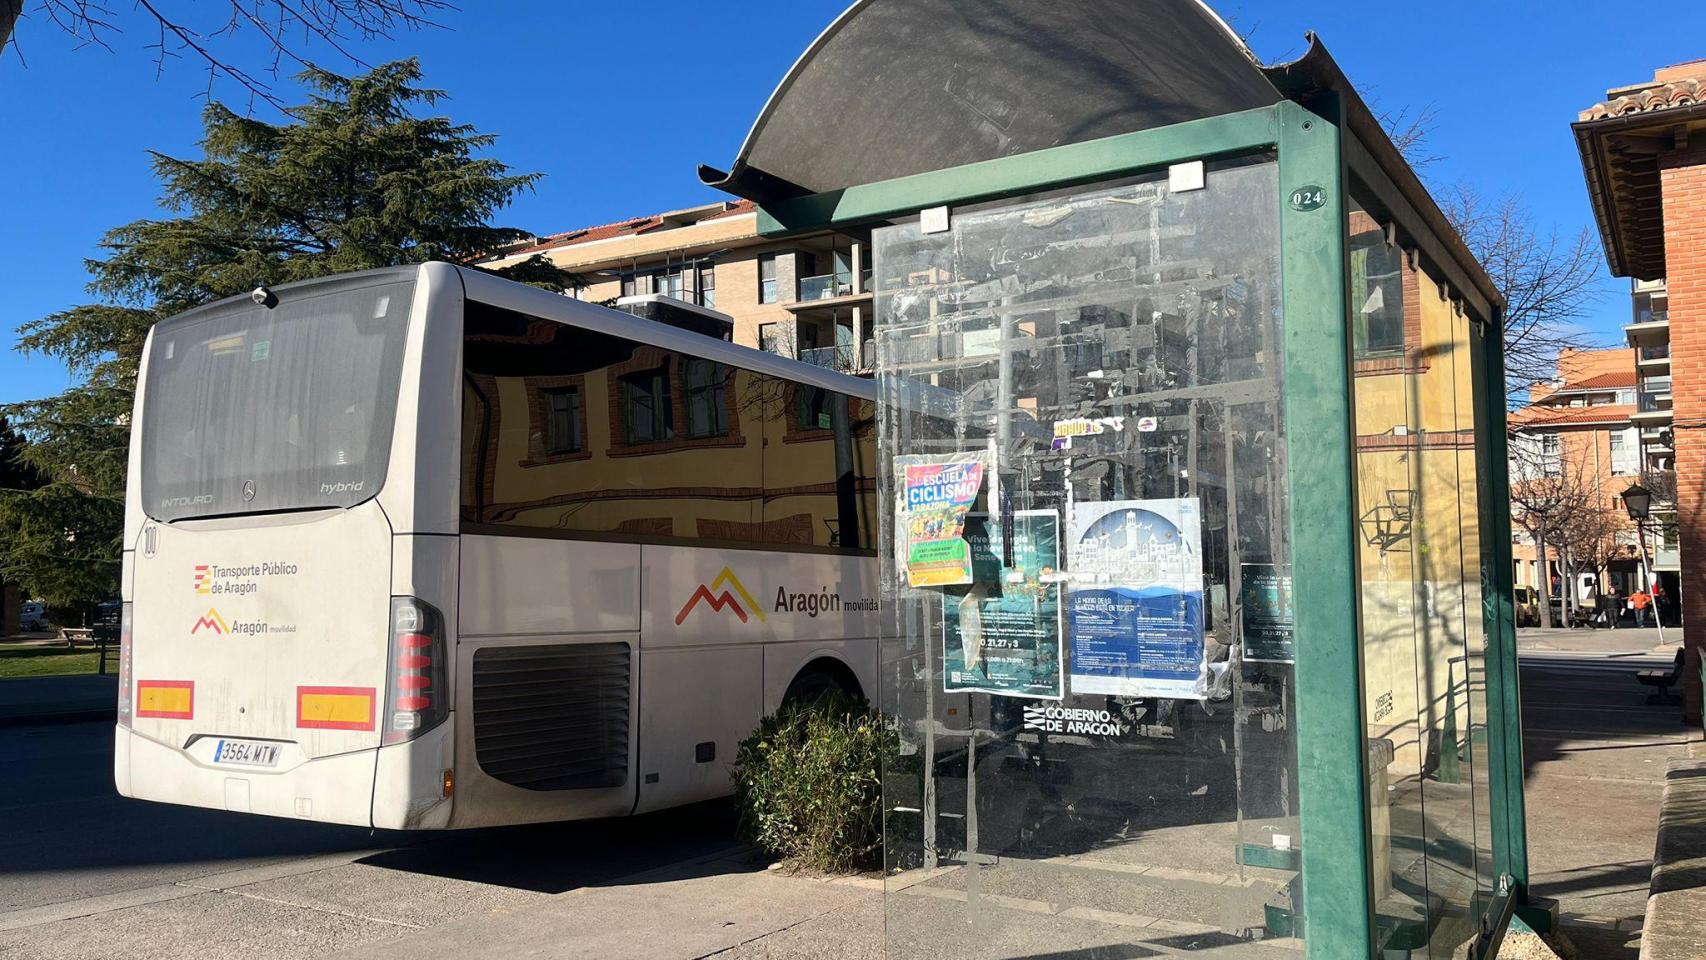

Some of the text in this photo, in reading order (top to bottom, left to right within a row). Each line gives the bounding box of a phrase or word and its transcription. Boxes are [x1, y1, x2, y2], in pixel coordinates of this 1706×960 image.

[1293, 191, 1321, 205] 024
[923, 470, 968, 486] ESCUELA
[320, 481, 364, 495] hybrid
[910, 481, 976, 503] CICLISMO
[161, 494, 214, 508] INTOURO
[212, 562, 298, 579] Transporte Público
[211, 580, 257, 595] de Aragón
[775, 586, 840, 618] Aragón
[232, 619, 297, 636] Aragón movilidad
[980, 638, 1007, 648] 0,21,27
[1045, 707, 1110, 723] GOBIERNO
[1046, 720, 1121, 736] DE ARAGON
[222, 743, 251, 760] 3564
